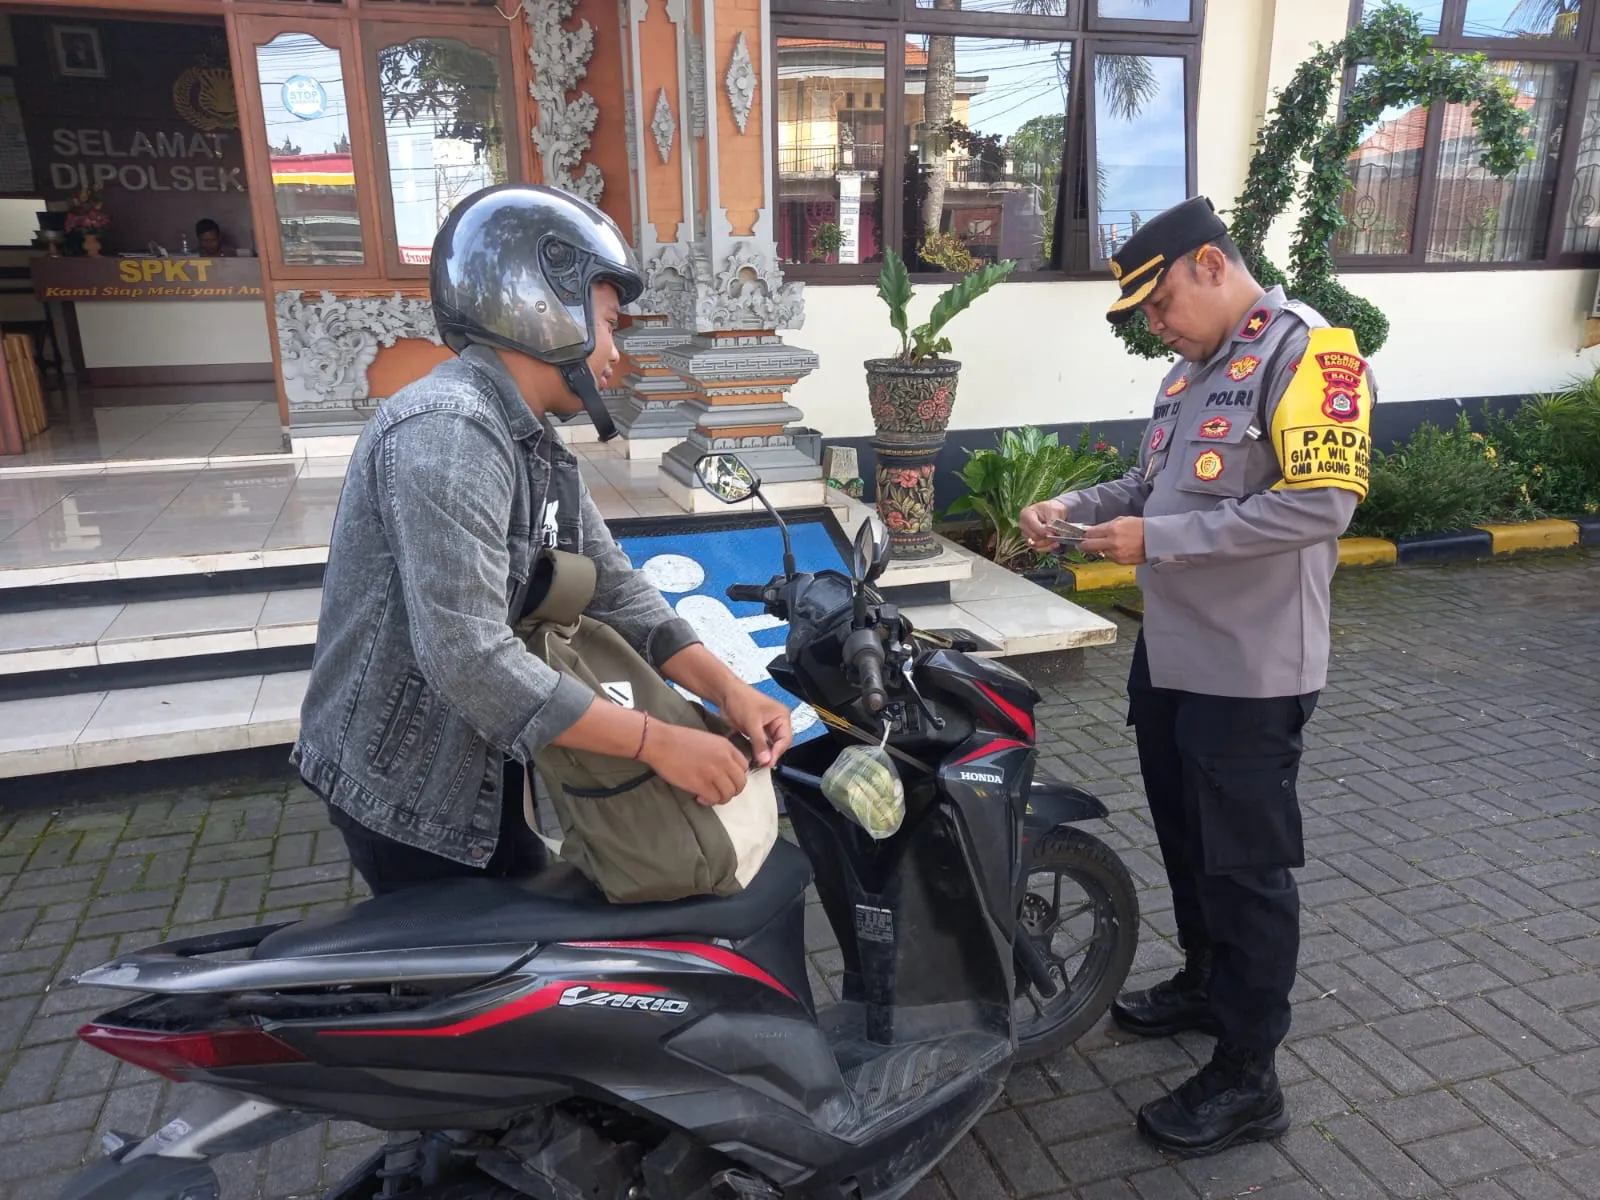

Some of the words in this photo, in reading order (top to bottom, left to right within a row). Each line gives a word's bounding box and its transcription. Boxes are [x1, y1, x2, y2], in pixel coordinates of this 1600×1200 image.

[290, 90, 318, 100] STOP
[53, 128, 229, 159] SELAMAT
[119, 259, 213, 282] SPKT
[46, 287, 98, 297] Kami
[102, 287, 143, 298] Siap
[147, 286, 233, 298] Melayani
[237, 286, 263, 296] An
[1331, 372, 1354, 383] BALI
[1205, 390, 1254, 407] POLRI
[1290, 447, 1320, 463] GIAT
[1328, 447, 1348, 461] WIL
[1290, 462, 1312, 476] OMB
[1317, 460, 1350, 475] AGUNG
[960, 771, 1003, 785] HONDA
[558, 985, 689, 1014] VARIO
